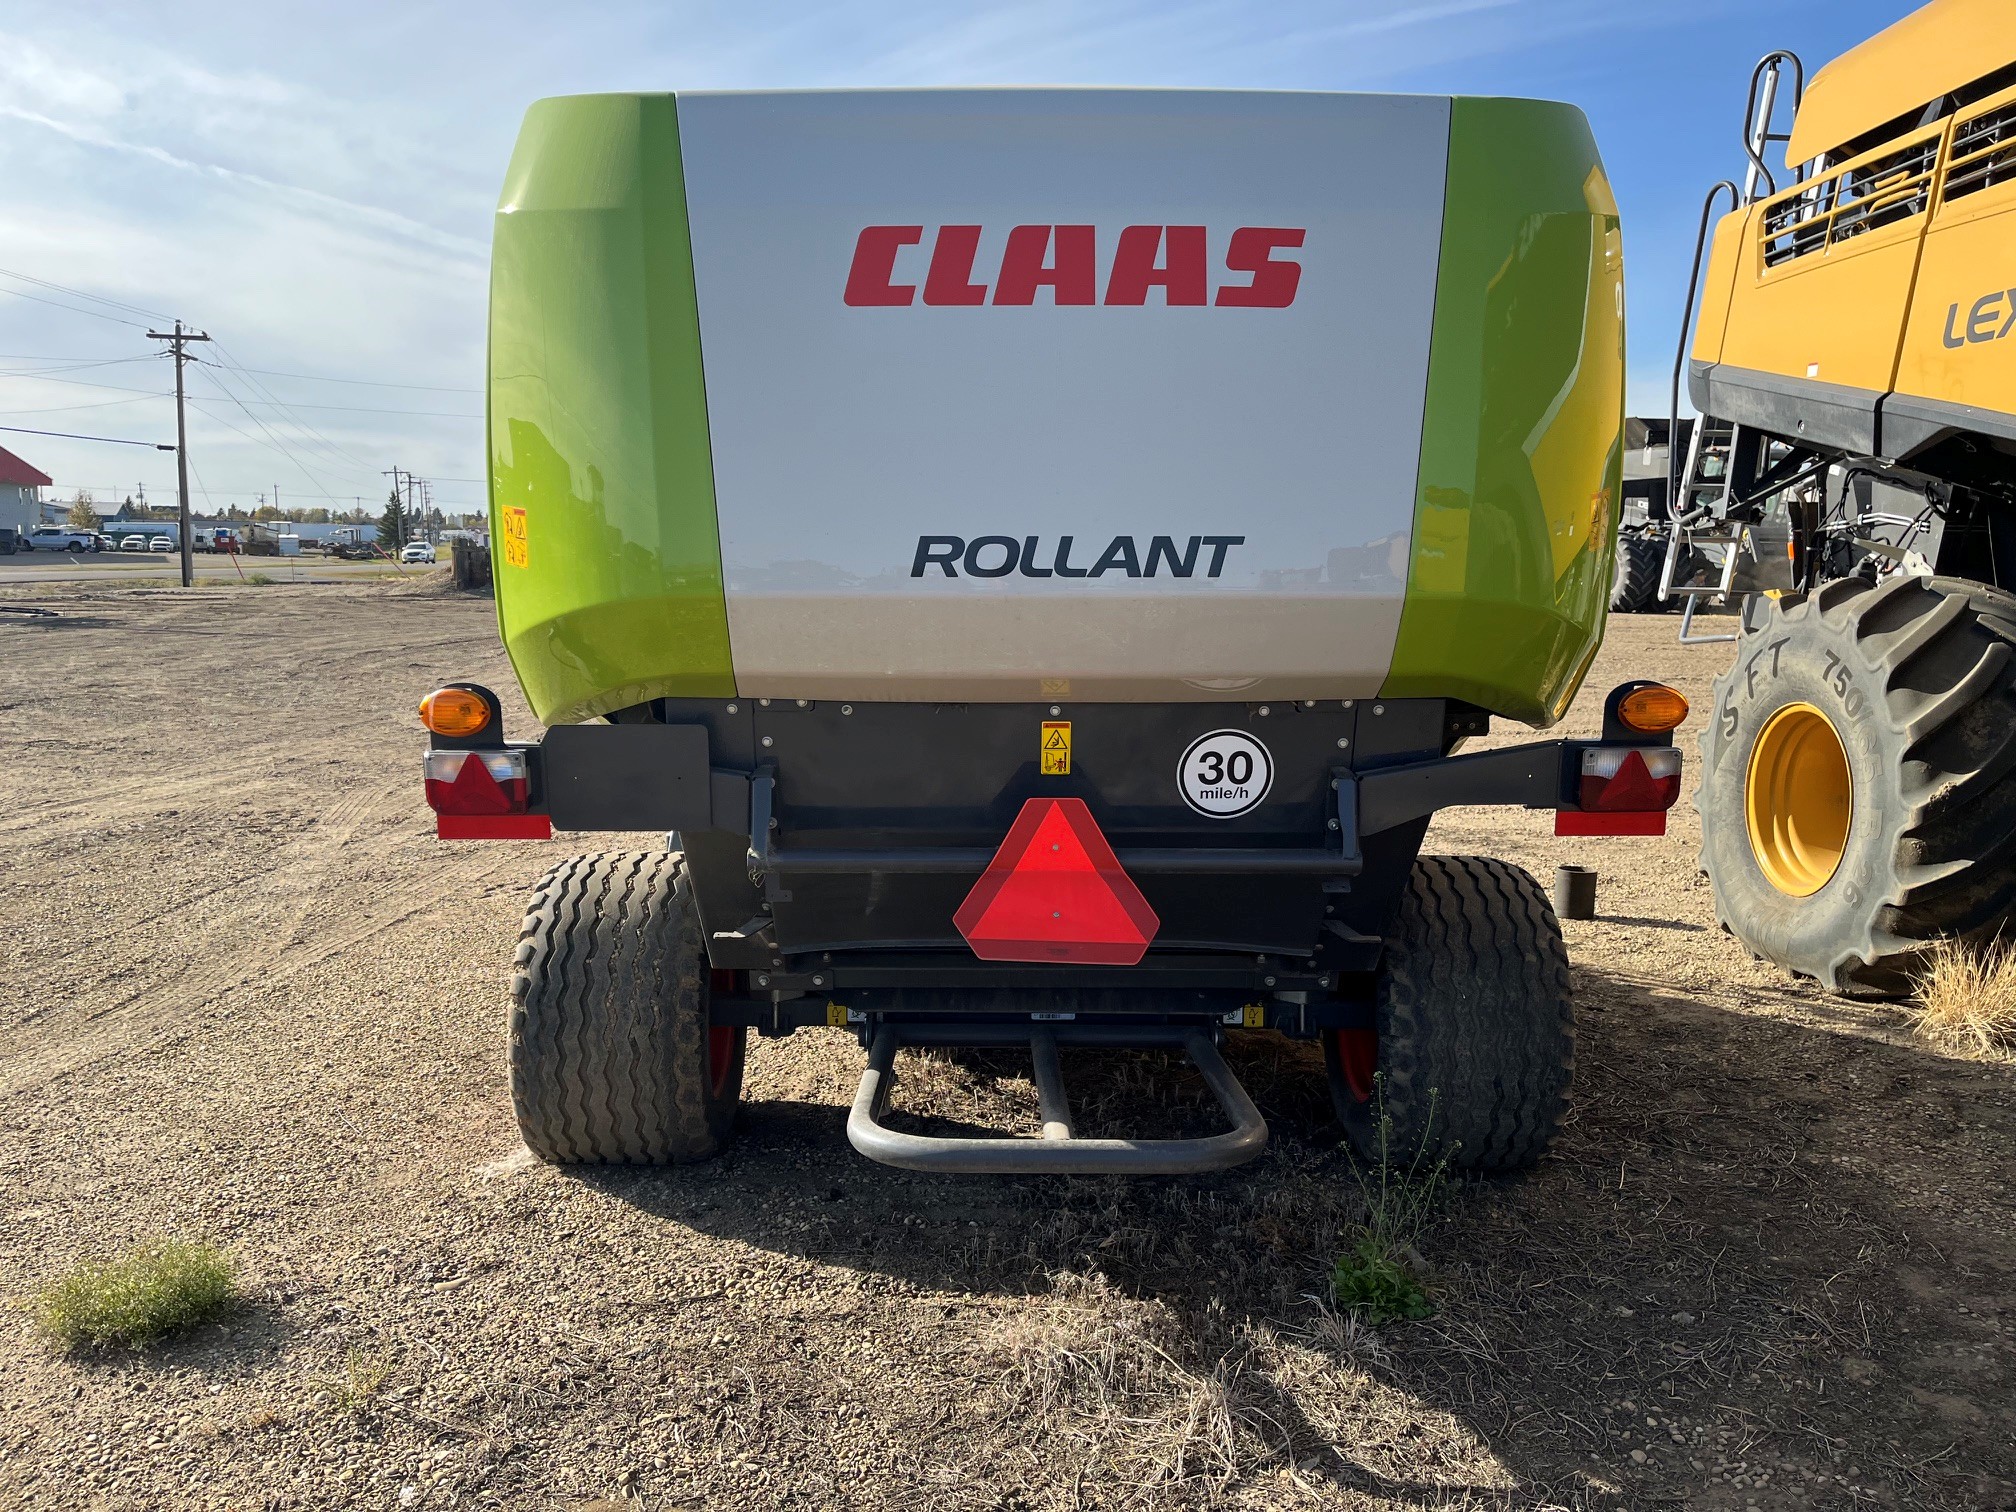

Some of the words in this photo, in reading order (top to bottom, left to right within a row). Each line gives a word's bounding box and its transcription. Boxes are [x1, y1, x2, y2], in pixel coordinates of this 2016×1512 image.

[844, 225, 1306, 308] CLAAS
[911, 535, 1246, 578] ROLLANT
[1197, 751, 1254, 786] 30
[1200, 786, 1249, 799] mile/h
